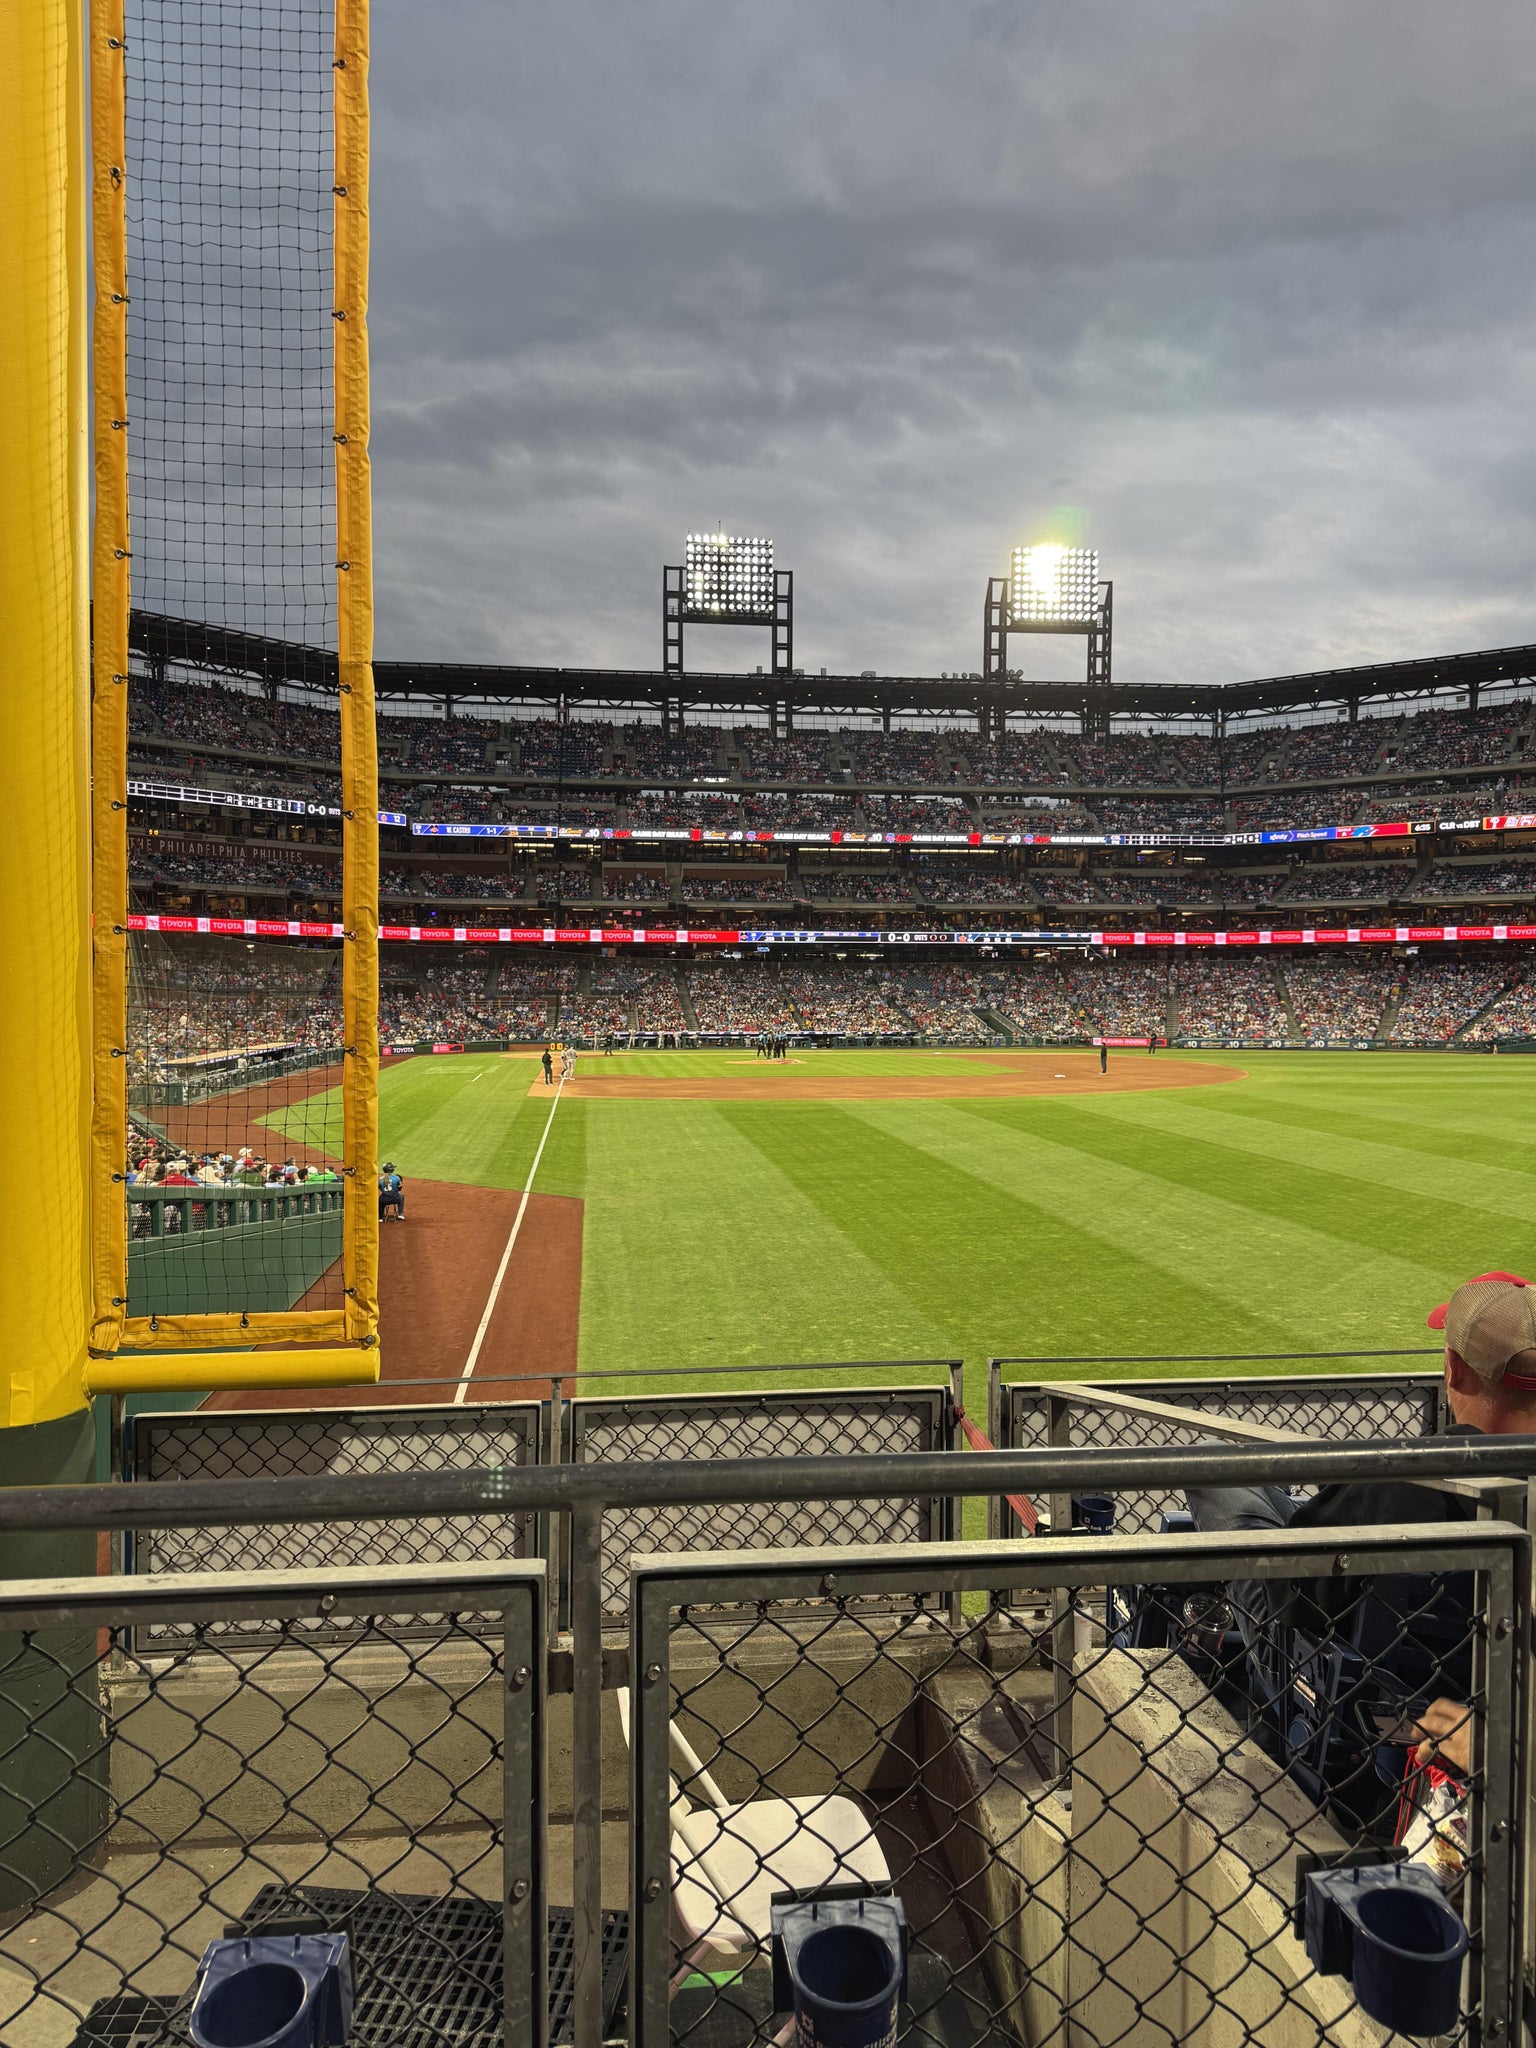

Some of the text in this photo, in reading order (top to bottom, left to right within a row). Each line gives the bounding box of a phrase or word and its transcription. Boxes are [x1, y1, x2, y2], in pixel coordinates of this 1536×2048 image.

[589, 828, 600, 838] 10
[732, 831, 744, 840] 10
[872, 833, 883, 842] 10
[1010, 834, 1021, 844] 10
[160, 840, 247, 857] PHILADELPHIA
[422, 930, 450, 938] TOYOTA
[1317, 932, 1346, 940] TOYOTA
[1510, 928, 1536, 936] TOYOT
[1187, 1040, 1198, 1048] 10
[1230, 1040, 1240, 1048] 10
[1271, 1040, 1282, 1048] 10
[1314, 1040, 1325, 1048] 10
[1357, 1042, 1368, 1050] 10
